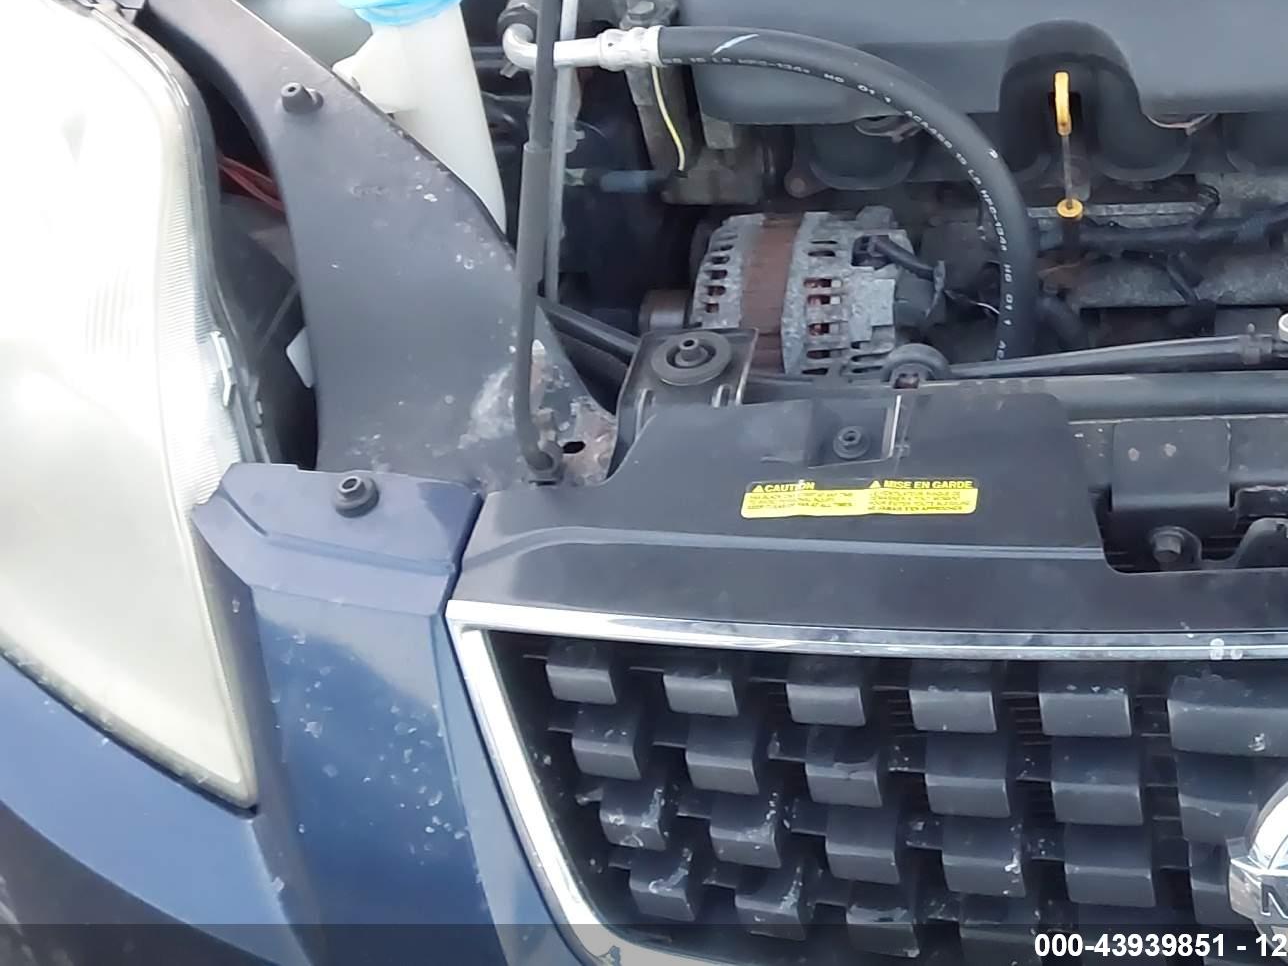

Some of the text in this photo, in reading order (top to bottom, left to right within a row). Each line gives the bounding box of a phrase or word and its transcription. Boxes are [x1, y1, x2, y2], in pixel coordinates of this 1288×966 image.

[882, 479, 974, 490] MISE EN GARDE
